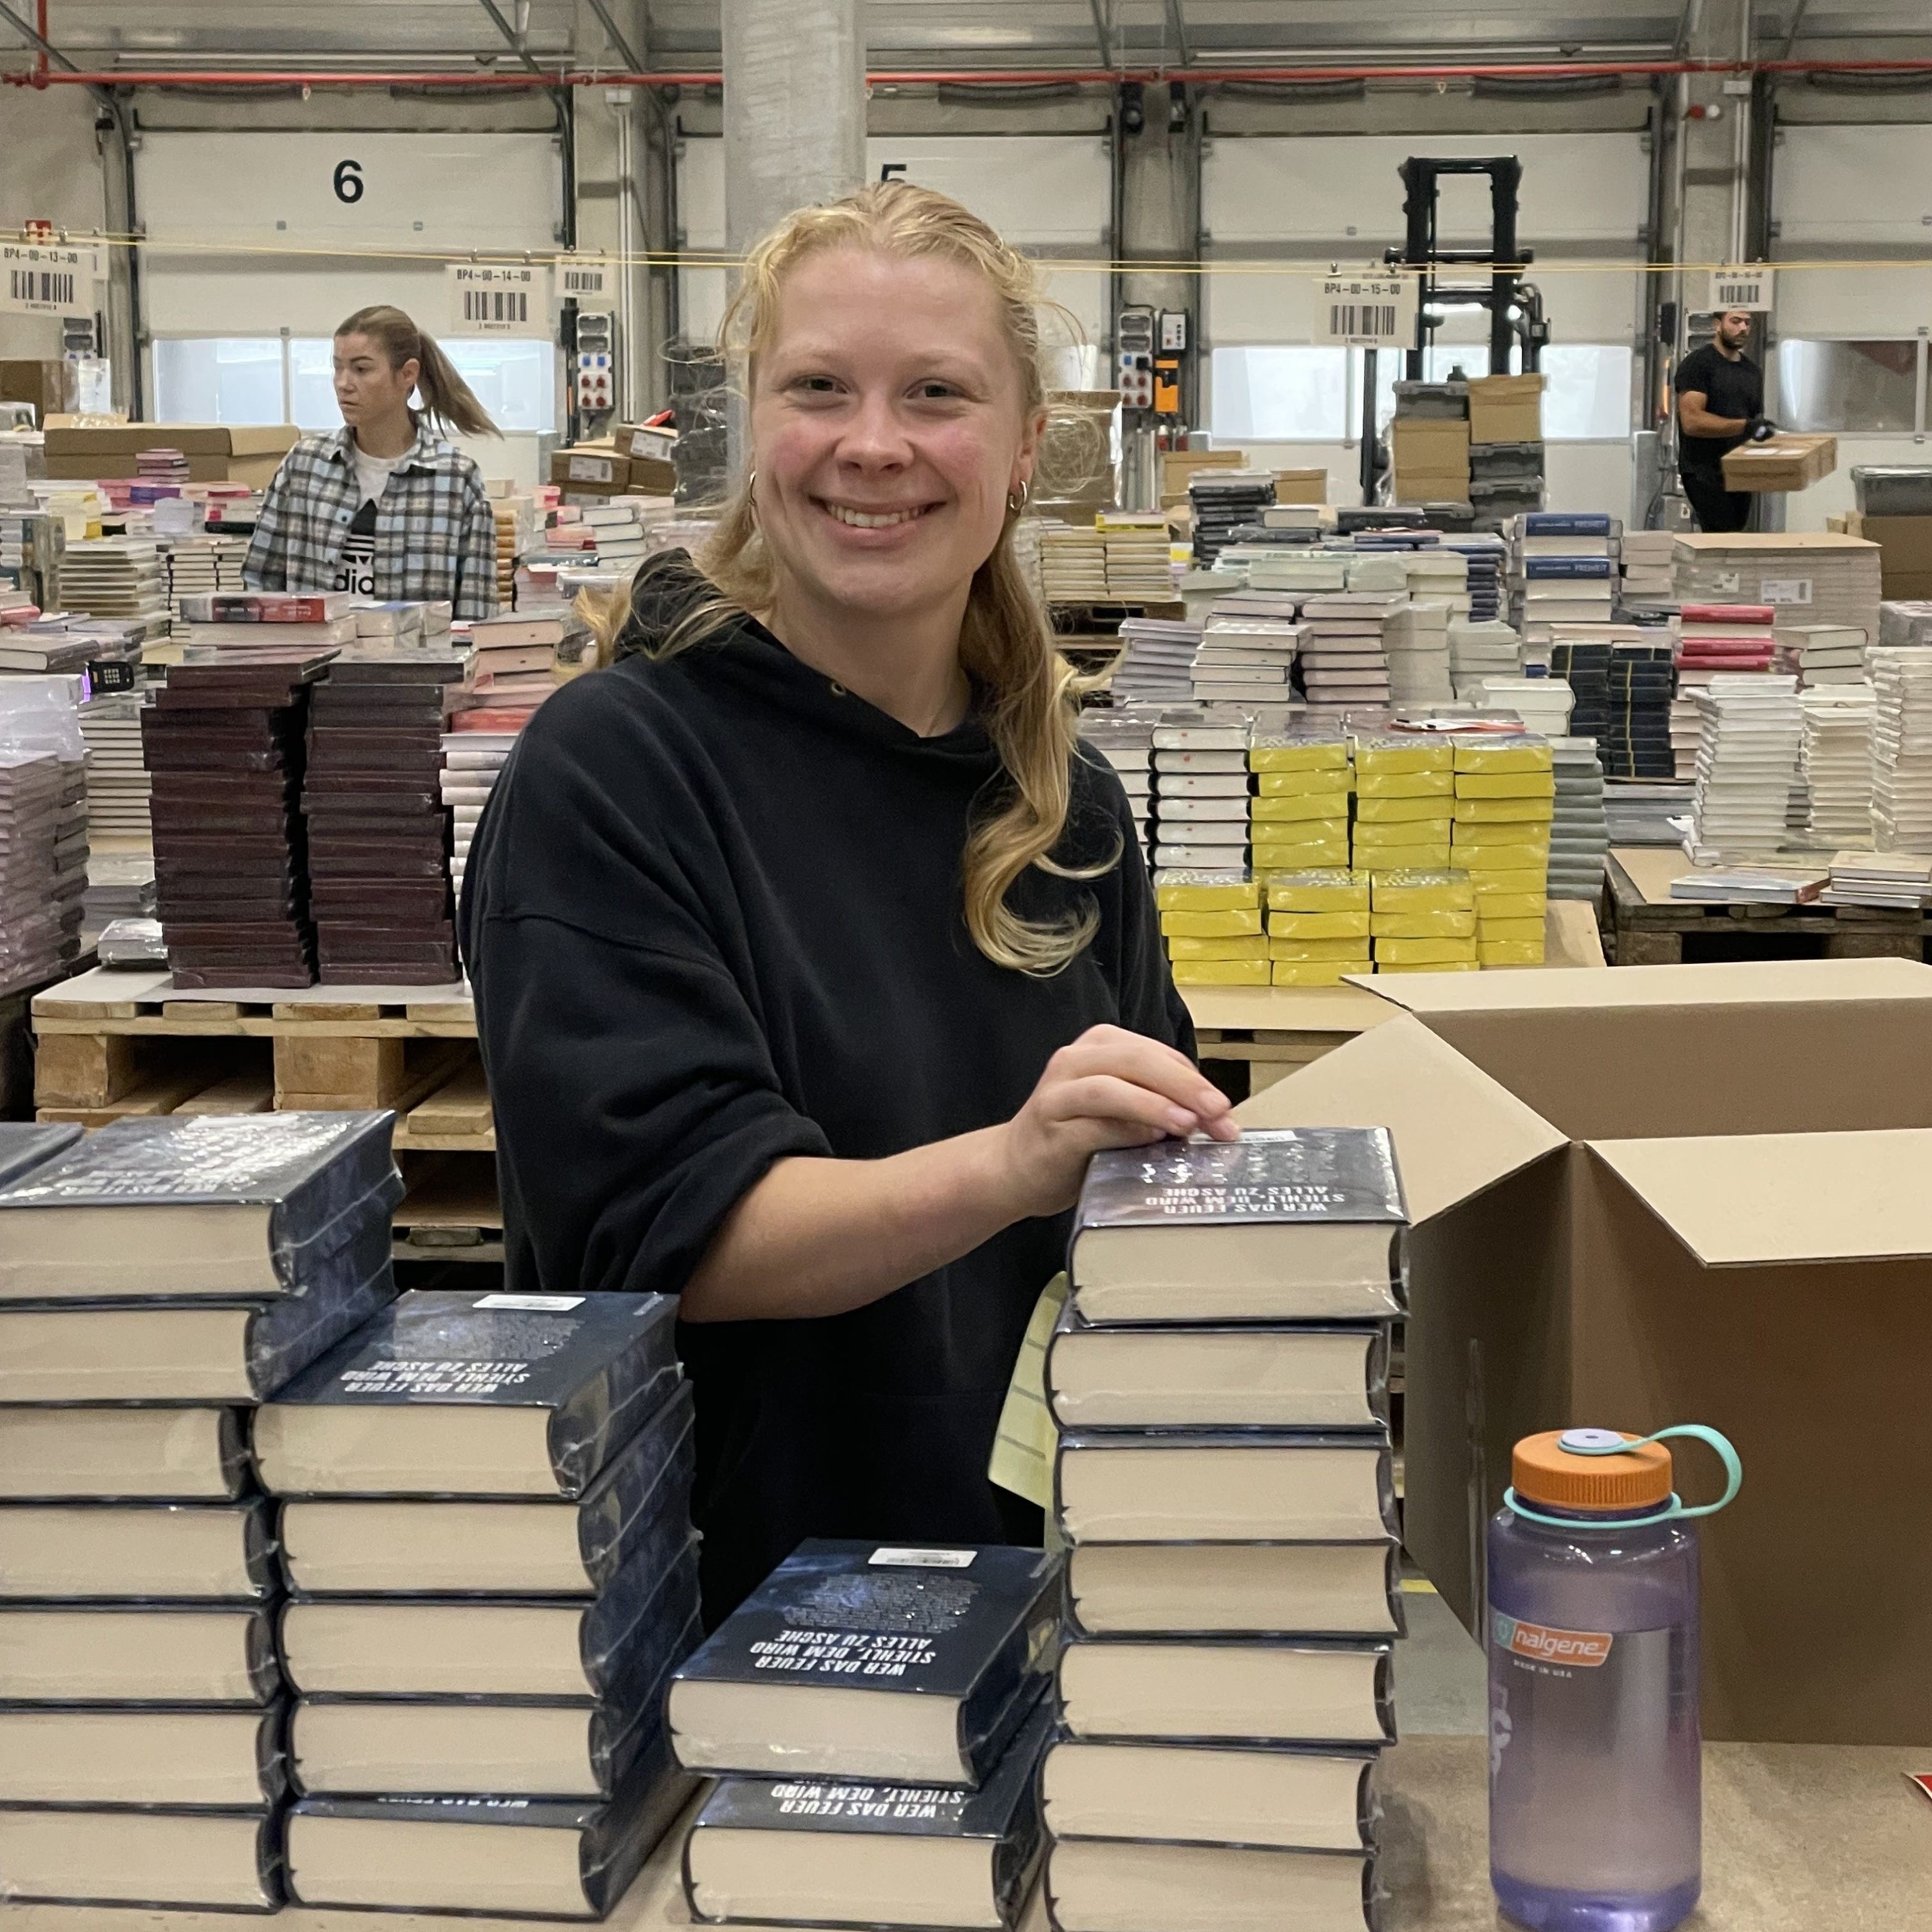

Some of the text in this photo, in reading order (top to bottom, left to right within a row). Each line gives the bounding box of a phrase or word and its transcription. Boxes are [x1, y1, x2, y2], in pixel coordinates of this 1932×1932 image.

[334, 159, 364, 204] 6
[1235, 1187, 1260, 1197] ZU
[1267, 1186, 1329, 1196] ALLES
[1145, 1197, 1197, 1206] WIRD
[1164, 1202, 1328, 1214] WER DAS FEUER
[774, 1630, 933, 1650] ALLES ZU ASCHE
[1515, 1630, 1607, 1657] nalgene
[749, 1642, 936, 1664] STIEHLT, DEM WIRD
[754, 1655, 907, 1676] WER DAS FEUER
[770, 1784, 965, 1804] STIEHLT, DEM WIRD
[779, 1801, 937, 1818] WER DAS FEUER
